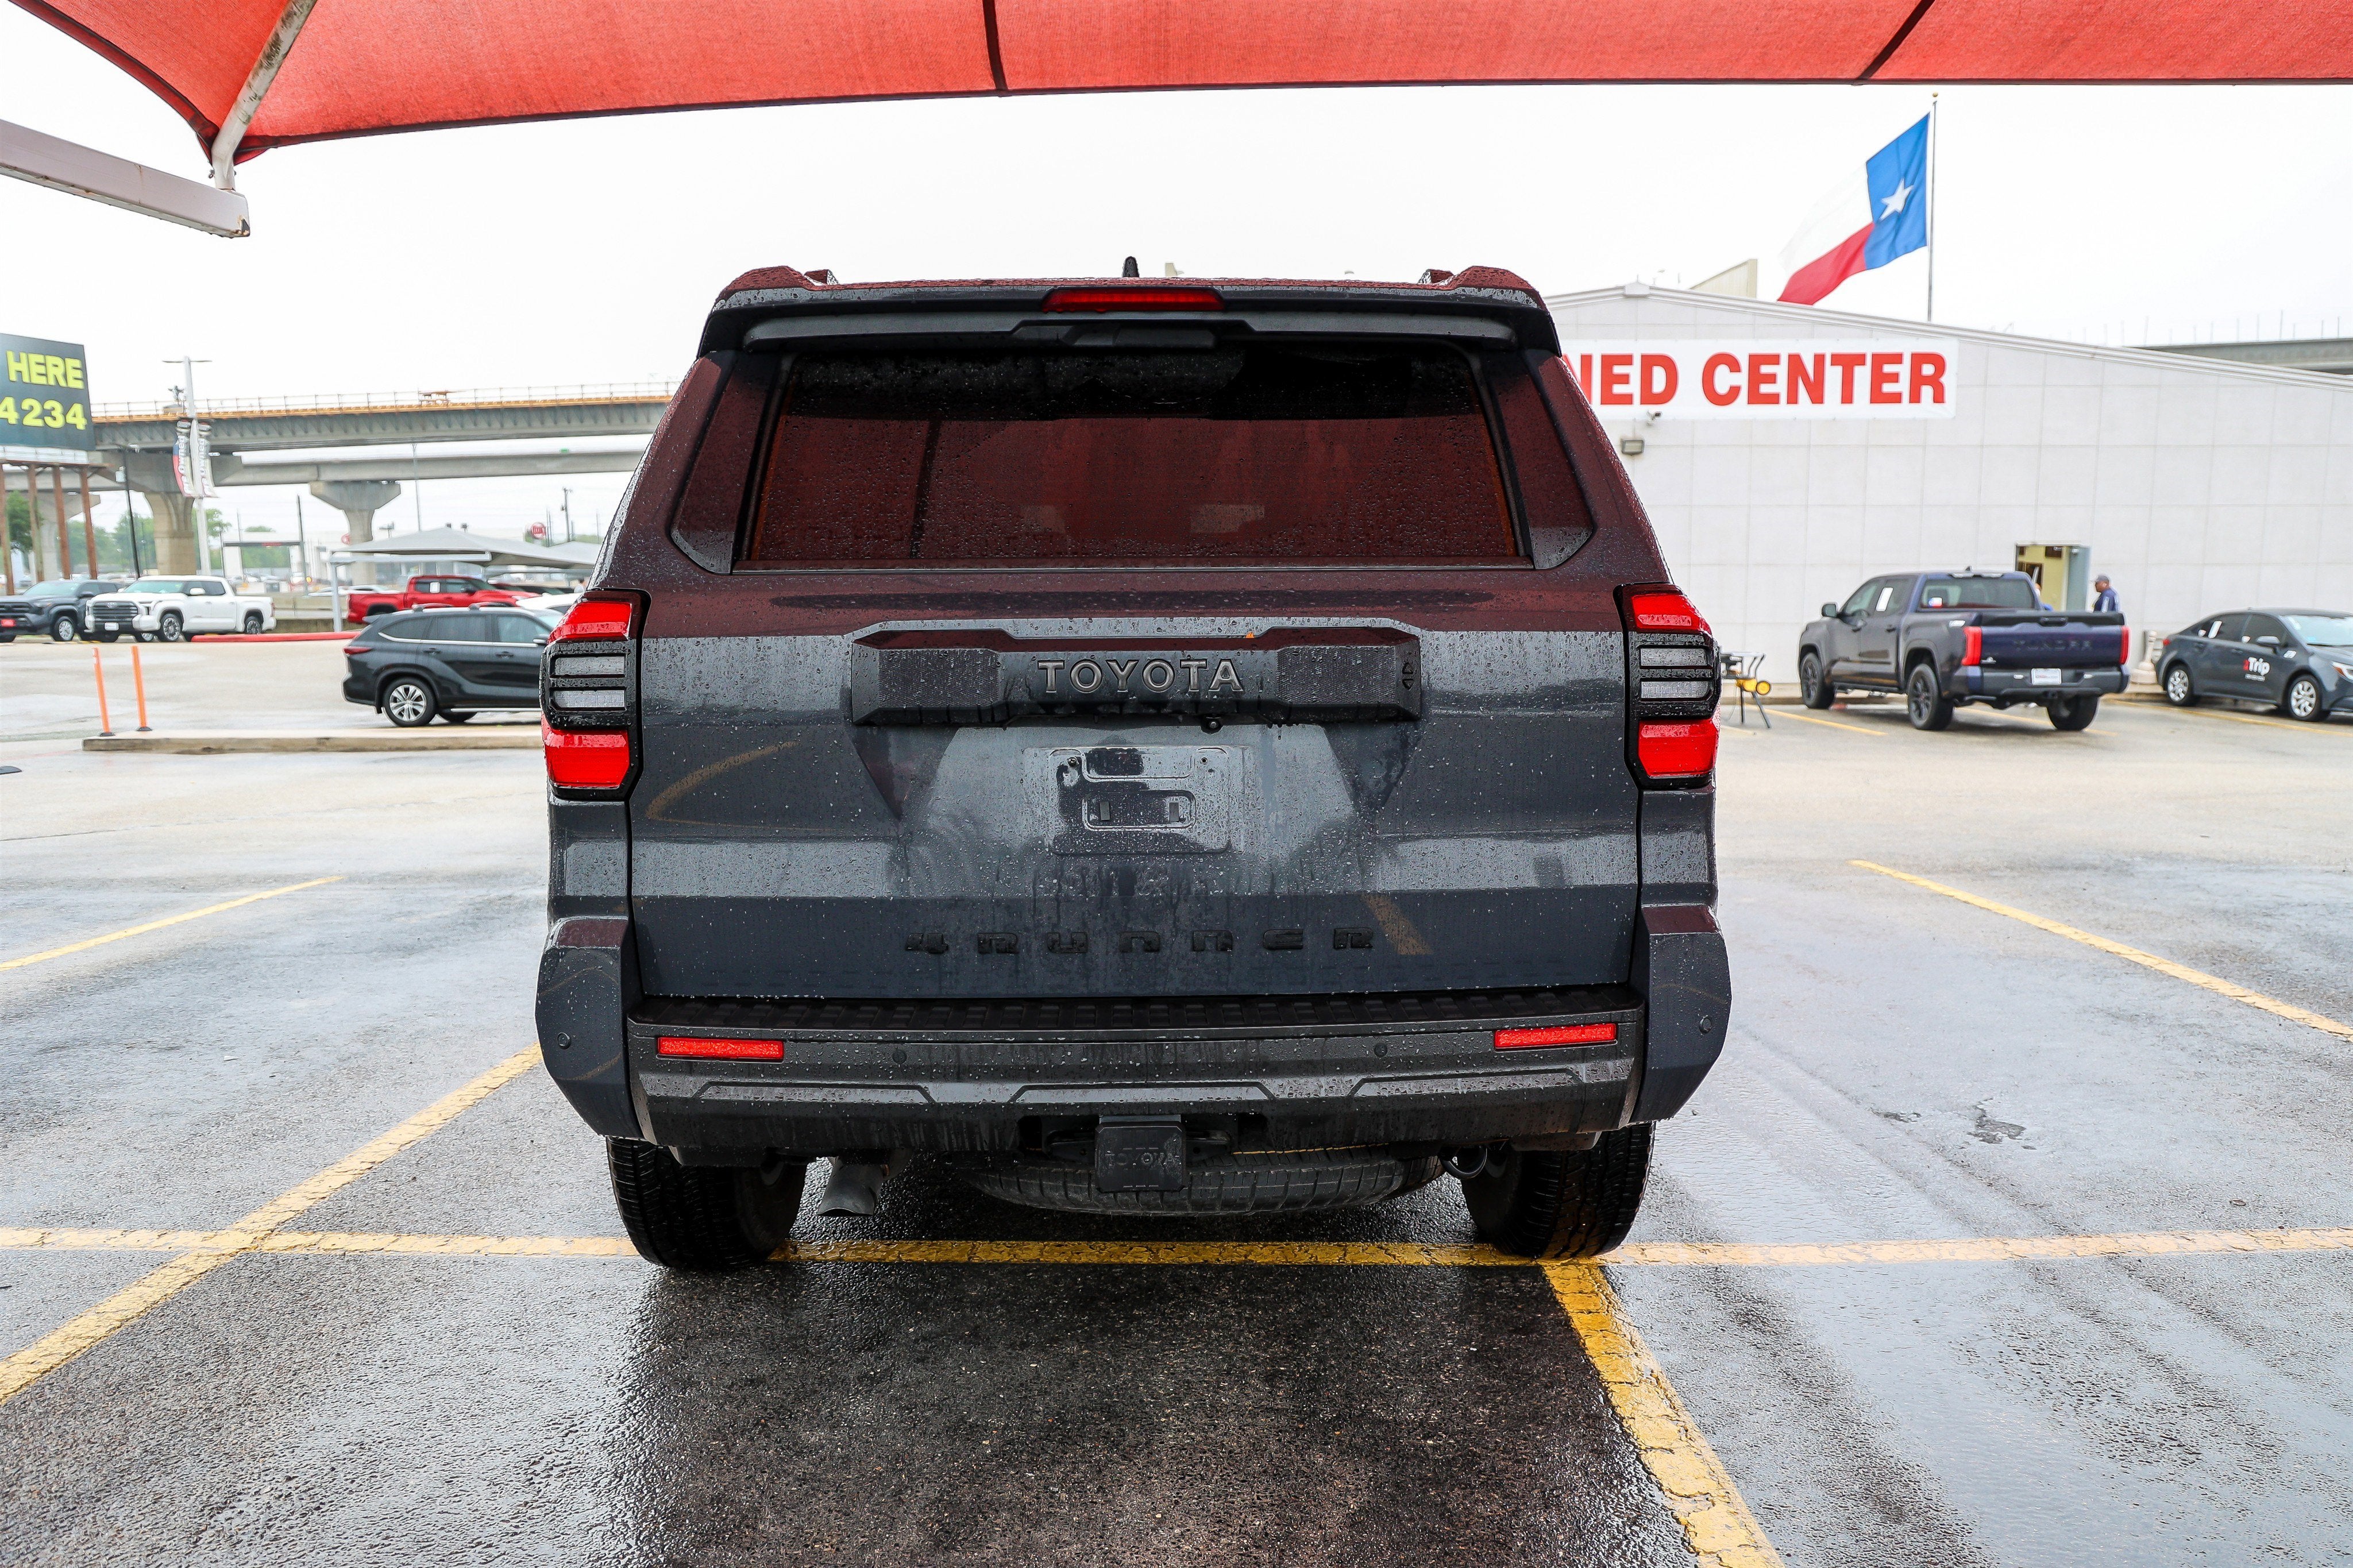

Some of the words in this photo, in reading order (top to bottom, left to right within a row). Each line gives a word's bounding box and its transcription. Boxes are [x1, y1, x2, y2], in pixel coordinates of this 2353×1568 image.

[6, 350, 84, 389] HERE
[1702, 352, 1946, 406] CENTER
[0, 396, 87, 430] 4234
[1037, 659, 1244, 693] TOYOTA
[904, 930, 1374, 955] 4RUNNER
